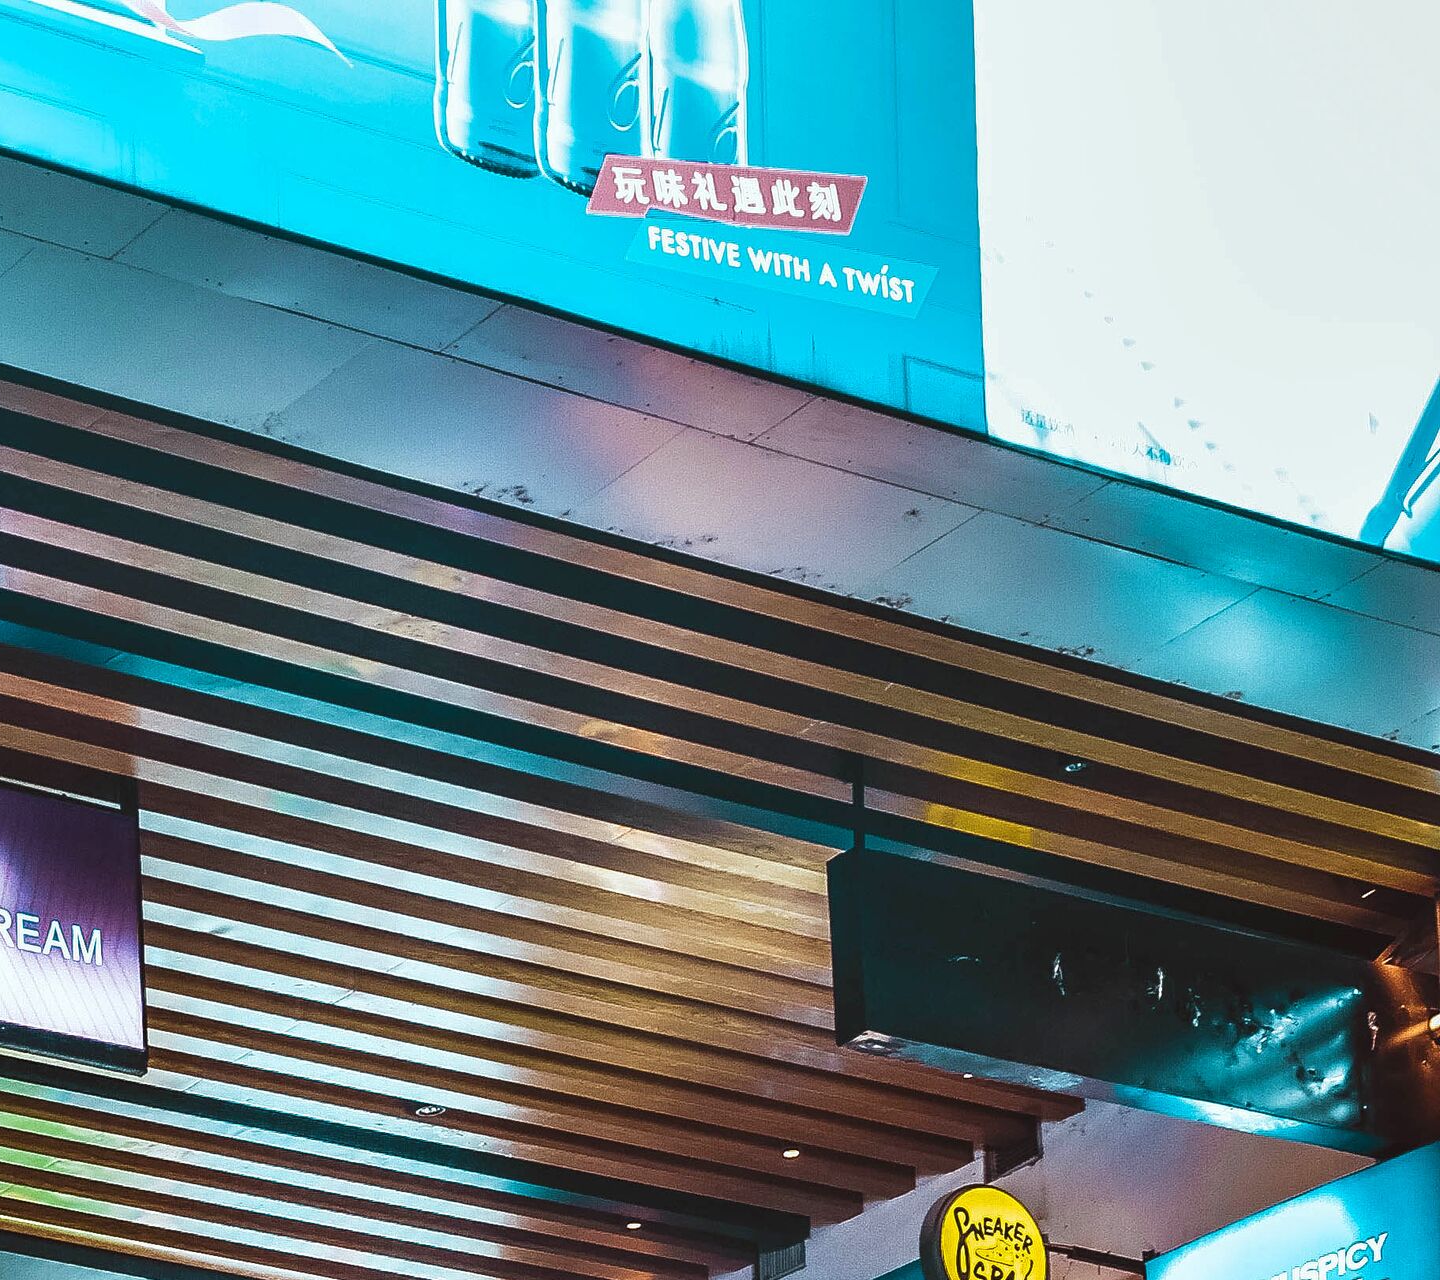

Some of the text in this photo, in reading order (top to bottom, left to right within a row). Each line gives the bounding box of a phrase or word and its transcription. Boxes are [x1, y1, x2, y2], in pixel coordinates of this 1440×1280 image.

[612, 165, 842, 222] 玩味礼遇此刻
[648, 226, 741, 268] FESTIVE
[747, 247, 810, 282] WITH
[819, 262, 838, 289] A
